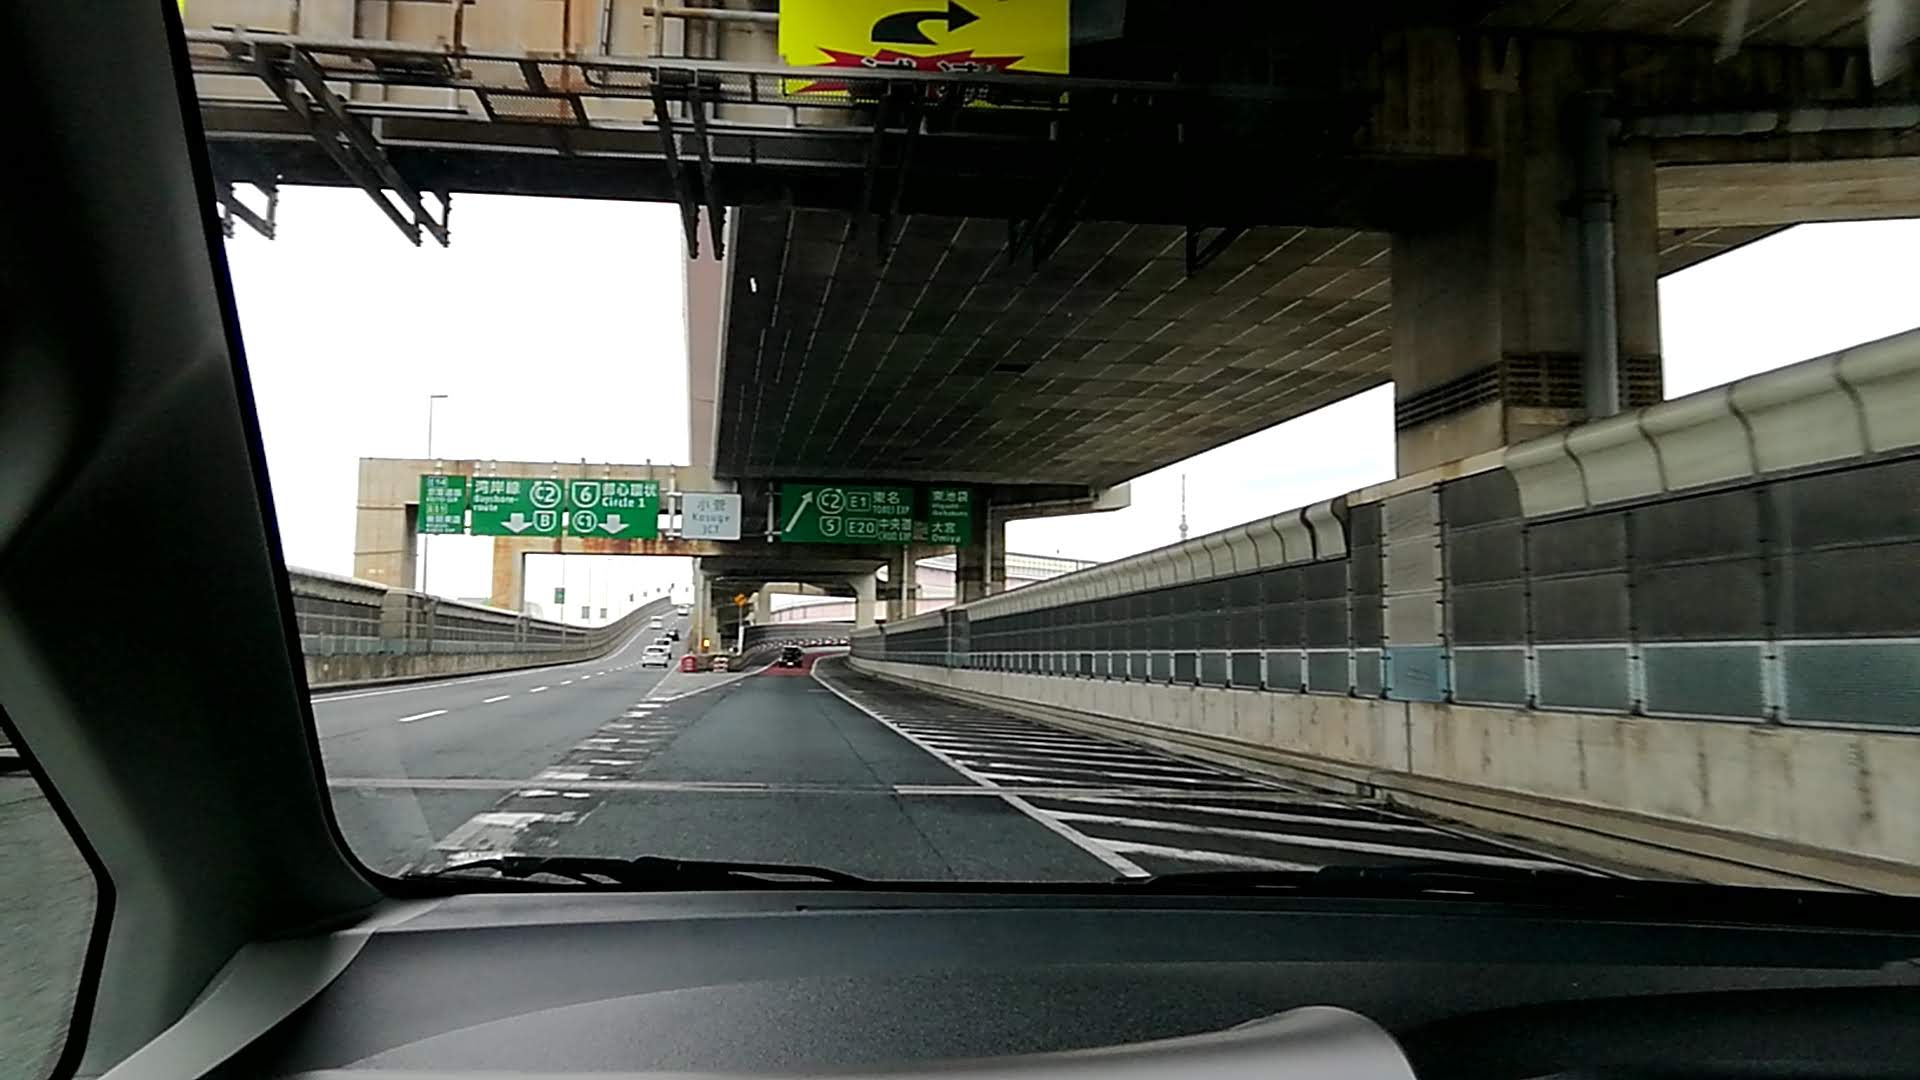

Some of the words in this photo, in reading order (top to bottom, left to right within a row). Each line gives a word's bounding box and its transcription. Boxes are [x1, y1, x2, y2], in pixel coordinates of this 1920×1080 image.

[535, 487, 556, 503] C2
[580, 486, 592, 502] 6
[873, 491, 900, 504] 東名
[602, 498, 634, 508] Circle
[638, 498, 646, 508] 1
[821, 494, 840, 509] C2
[850, 496, 867, 508] E1
[540, 515, 550, 527] B
[577, 515, 592, 528] C1
[849, 522, 875, 534] E20
[931, 522, 956, 533] 大宮
